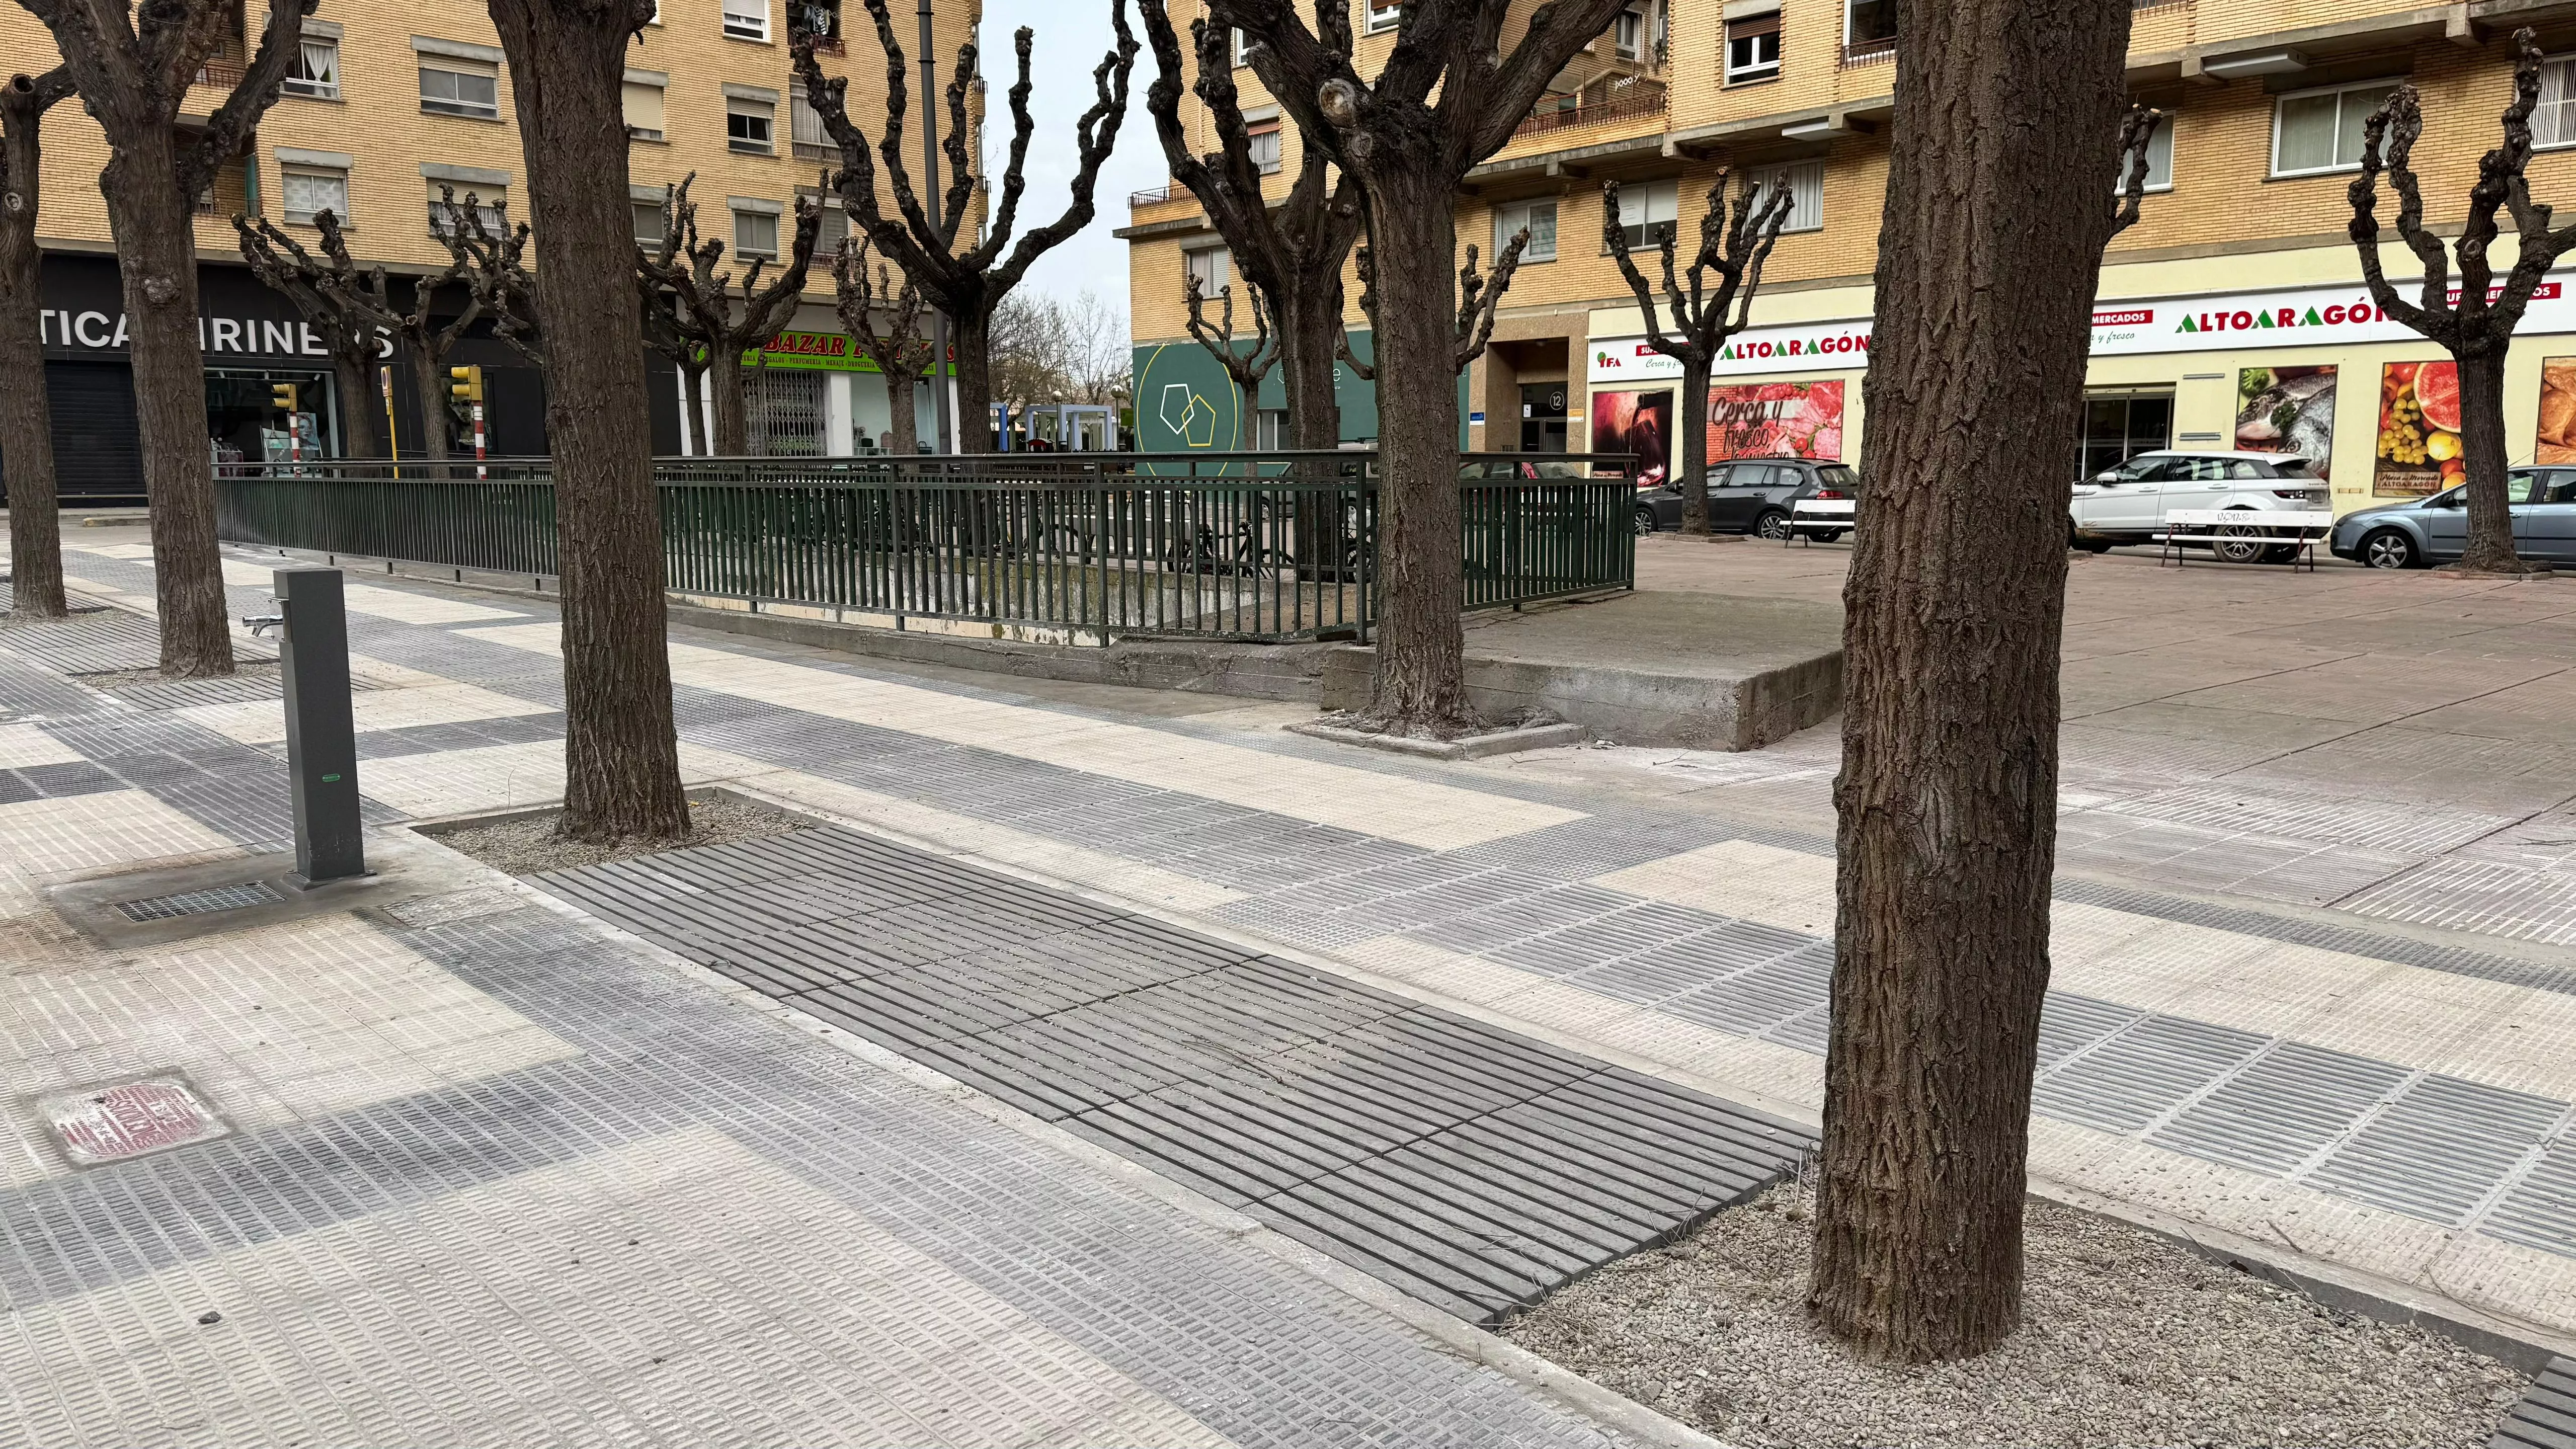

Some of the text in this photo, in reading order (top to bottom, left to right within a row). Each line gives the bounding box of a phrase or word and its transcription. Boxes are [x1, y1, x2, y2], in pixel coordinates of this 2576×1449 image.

[764, 334, 845, 355] BAZAR
[1720, 331, 1871, 360] ALTOARAGÓN
[2106, 331, 2135, 344] fresco
[1646, 358, 1664, 368] Cerca
[1553, 395, 1561, 407] 12
[1712, 396, 1784, 427] Cerca y
[1723, 425, 1770, 453] fresco,
